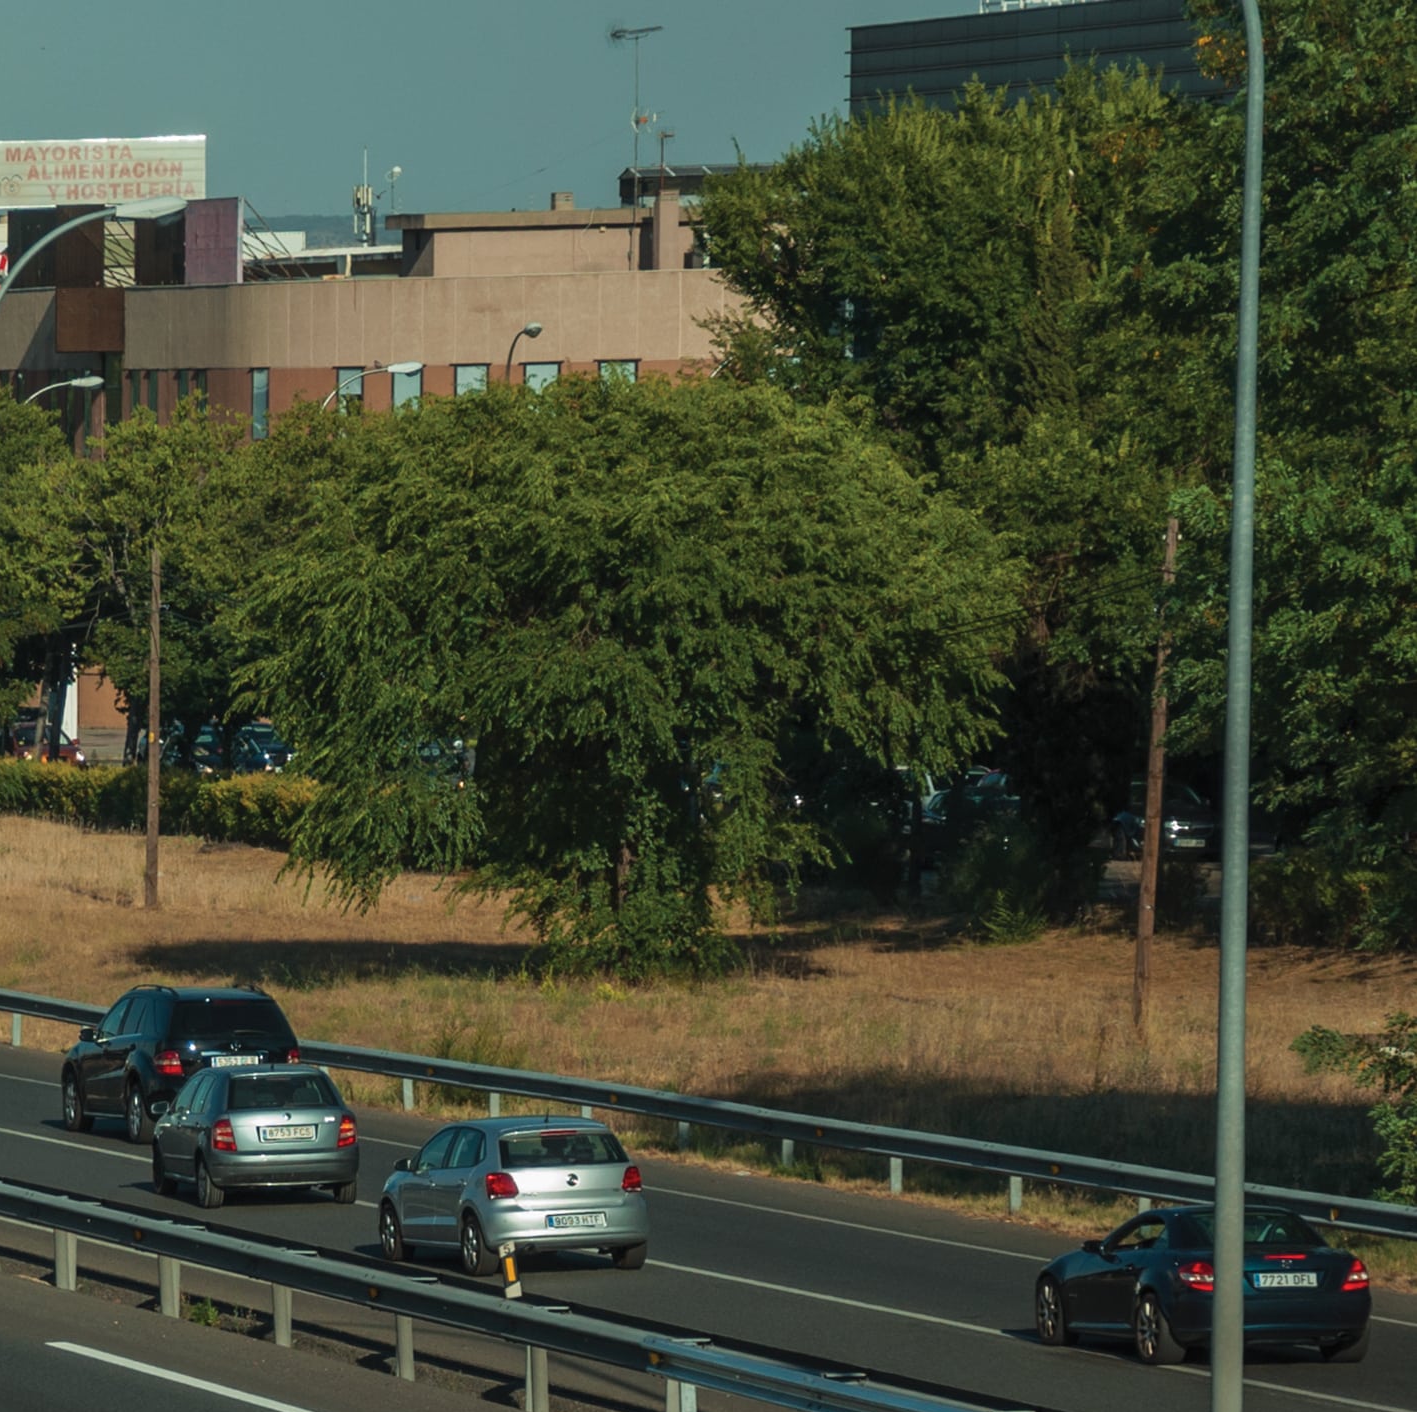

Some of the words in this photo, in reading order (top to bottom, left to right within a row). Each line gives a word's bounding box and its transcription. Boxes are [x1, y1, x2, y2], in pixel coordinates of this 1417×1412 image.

[5, 145, 133, 162] MAYORISTA
[27, 158, 183, 180] ALIMENTACIÓN
[48, 185, 58, 200] Y
[66, 178, 195, 200] HOSTELERÍA
[1260, 1273, 1289, 1288] 7721
[1292, 1272, 1315, 1287] DFL
